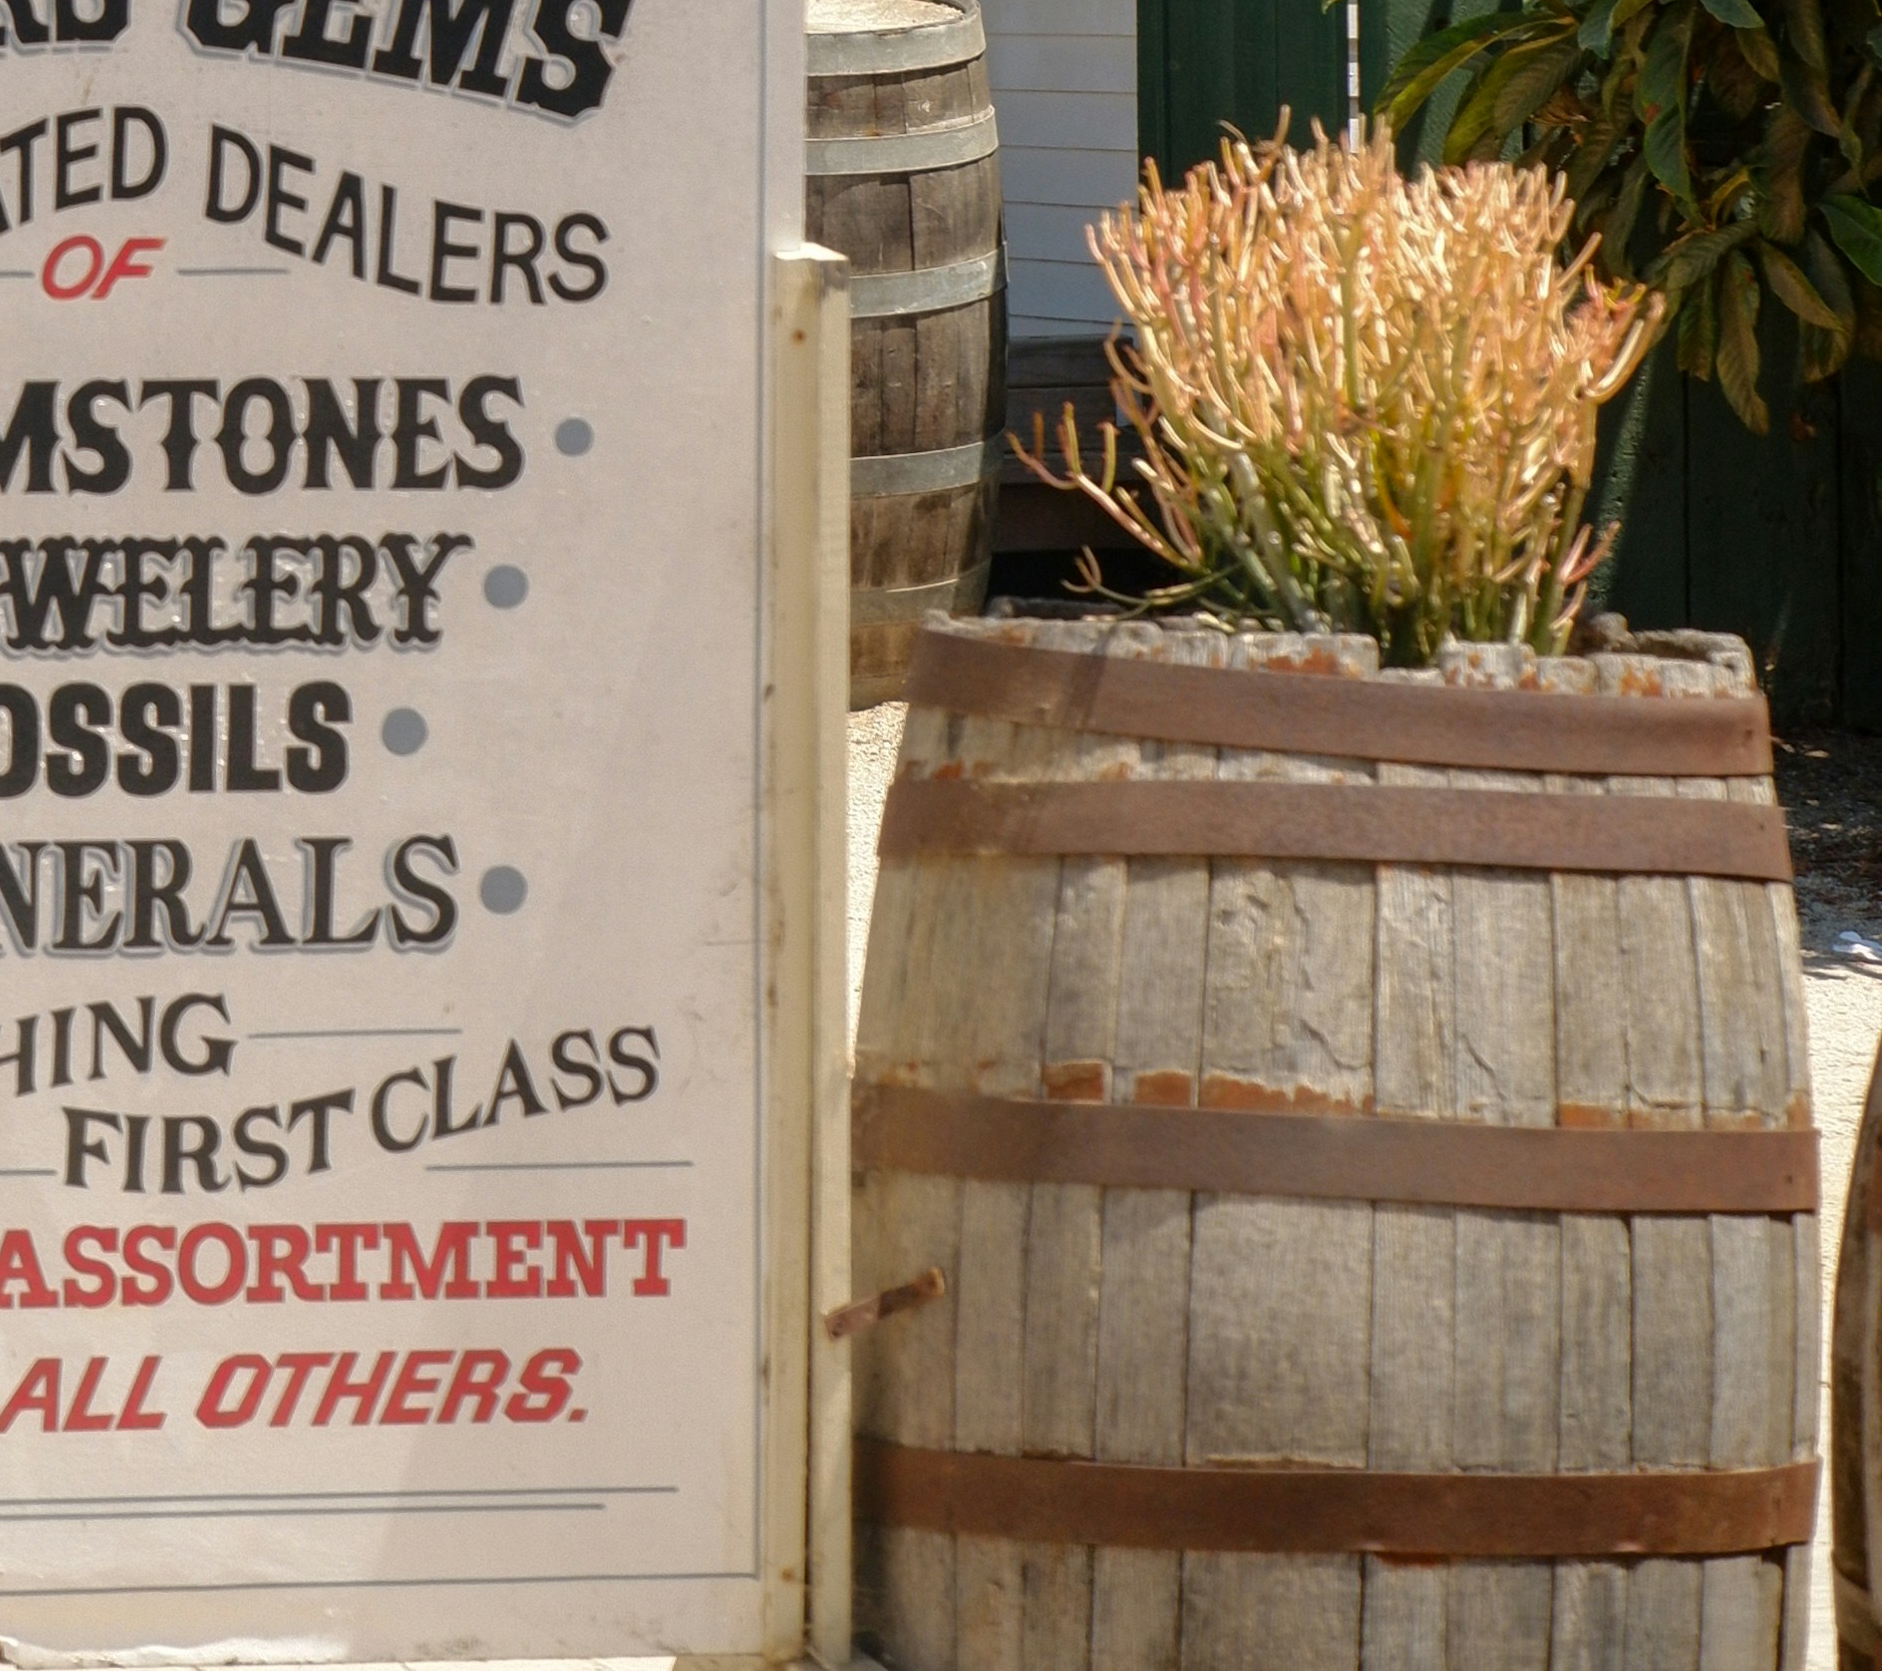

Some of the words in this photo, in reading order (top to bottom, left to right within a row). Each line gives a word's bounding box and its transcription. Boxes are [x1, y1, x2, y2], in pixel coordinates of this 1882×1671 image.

[40, 234, 168, 301] OF
[204, 124, 610, 306] DEALERS
[62, 1088, 354, 1196] FIRST
[368, 1024, 664, 1156] CLASS
[194, 1348, 590, 1432] OTHERS.
